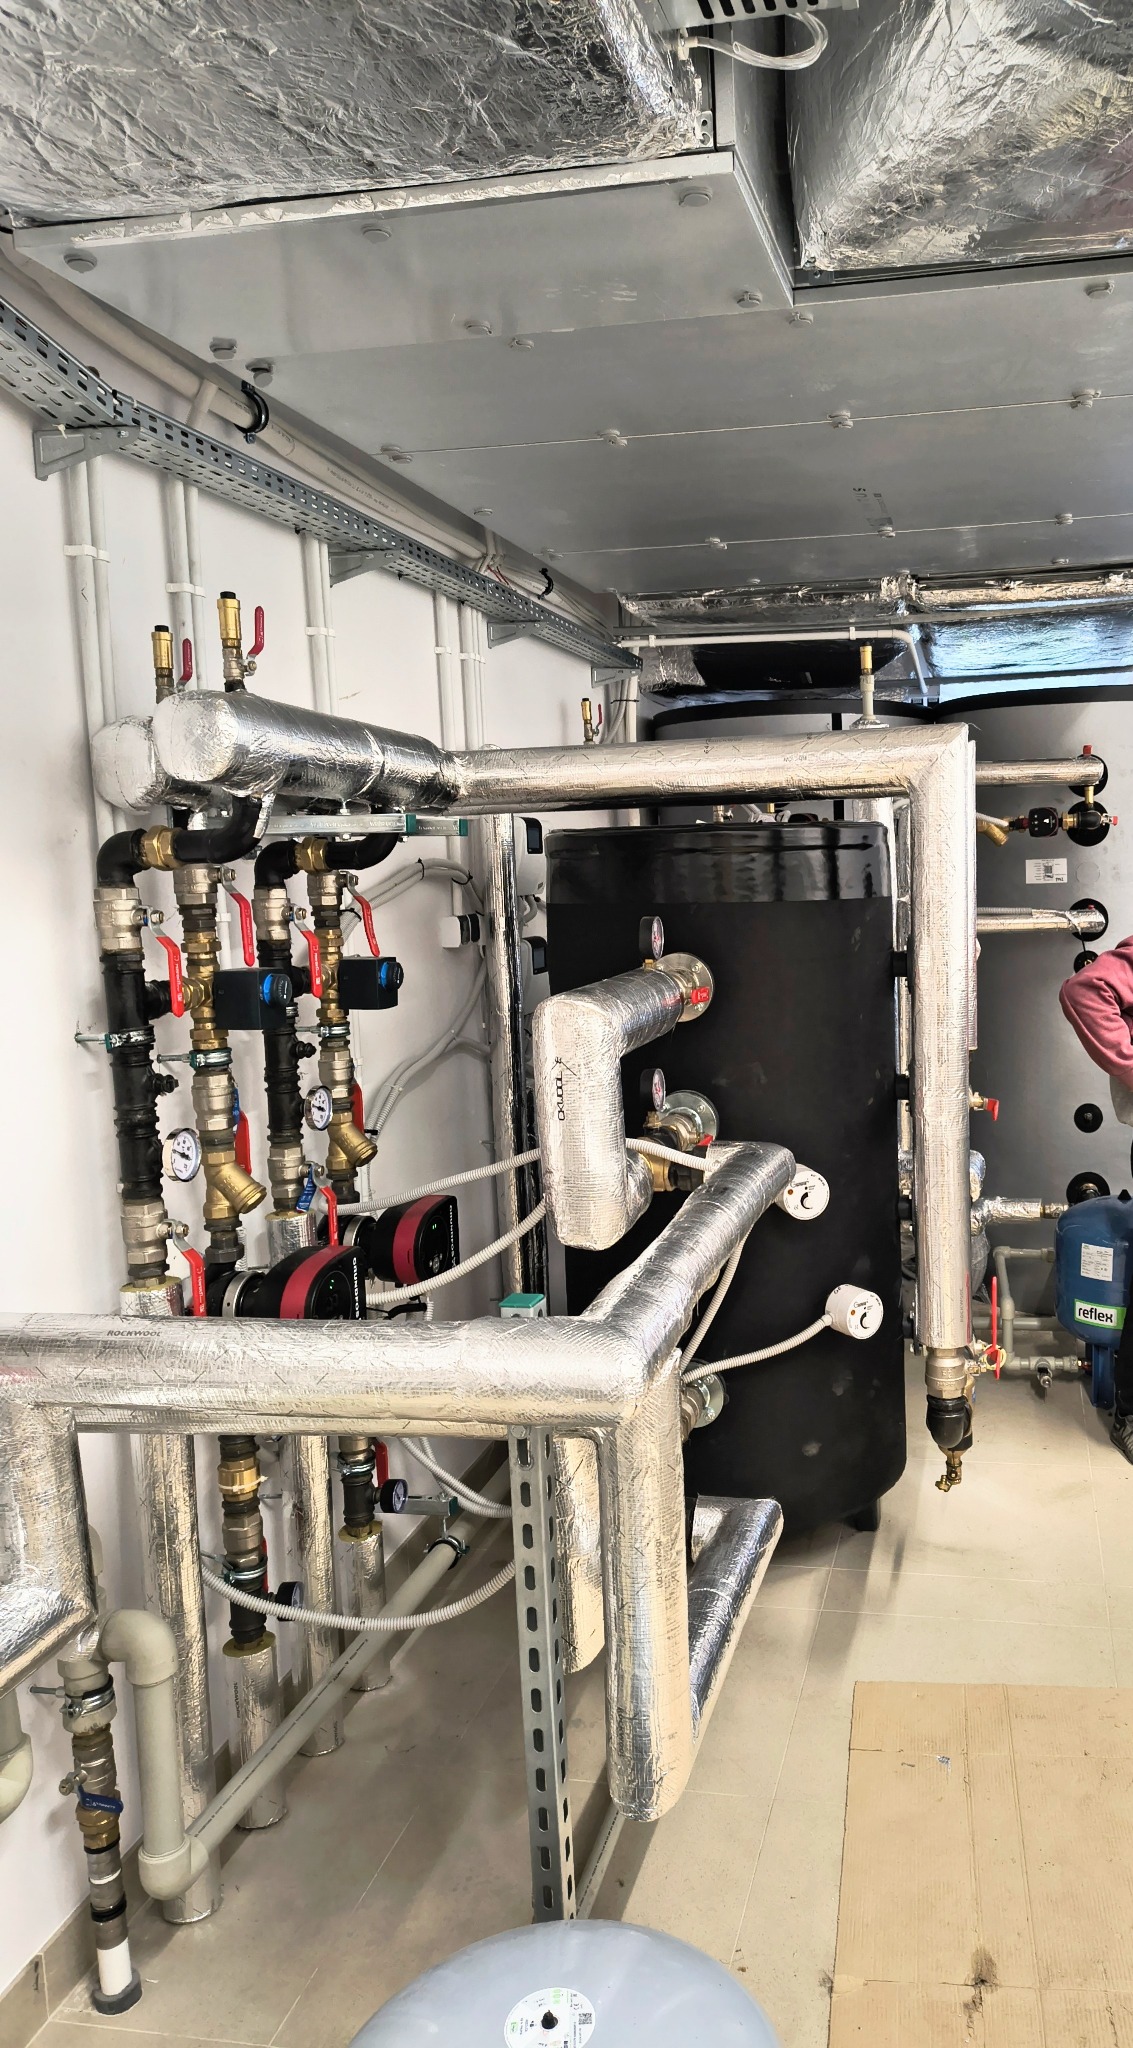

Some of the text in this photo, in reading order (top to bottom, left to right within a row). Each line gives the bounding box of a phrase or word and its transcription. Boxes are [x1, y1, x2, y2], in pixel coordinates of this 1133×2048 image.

[352, 1257, 360, 1318] GRUNDFOS
[1078, 1307, 1113, 1323] reflex
[106, 1329, 163, 1337] ROCKWOOL
